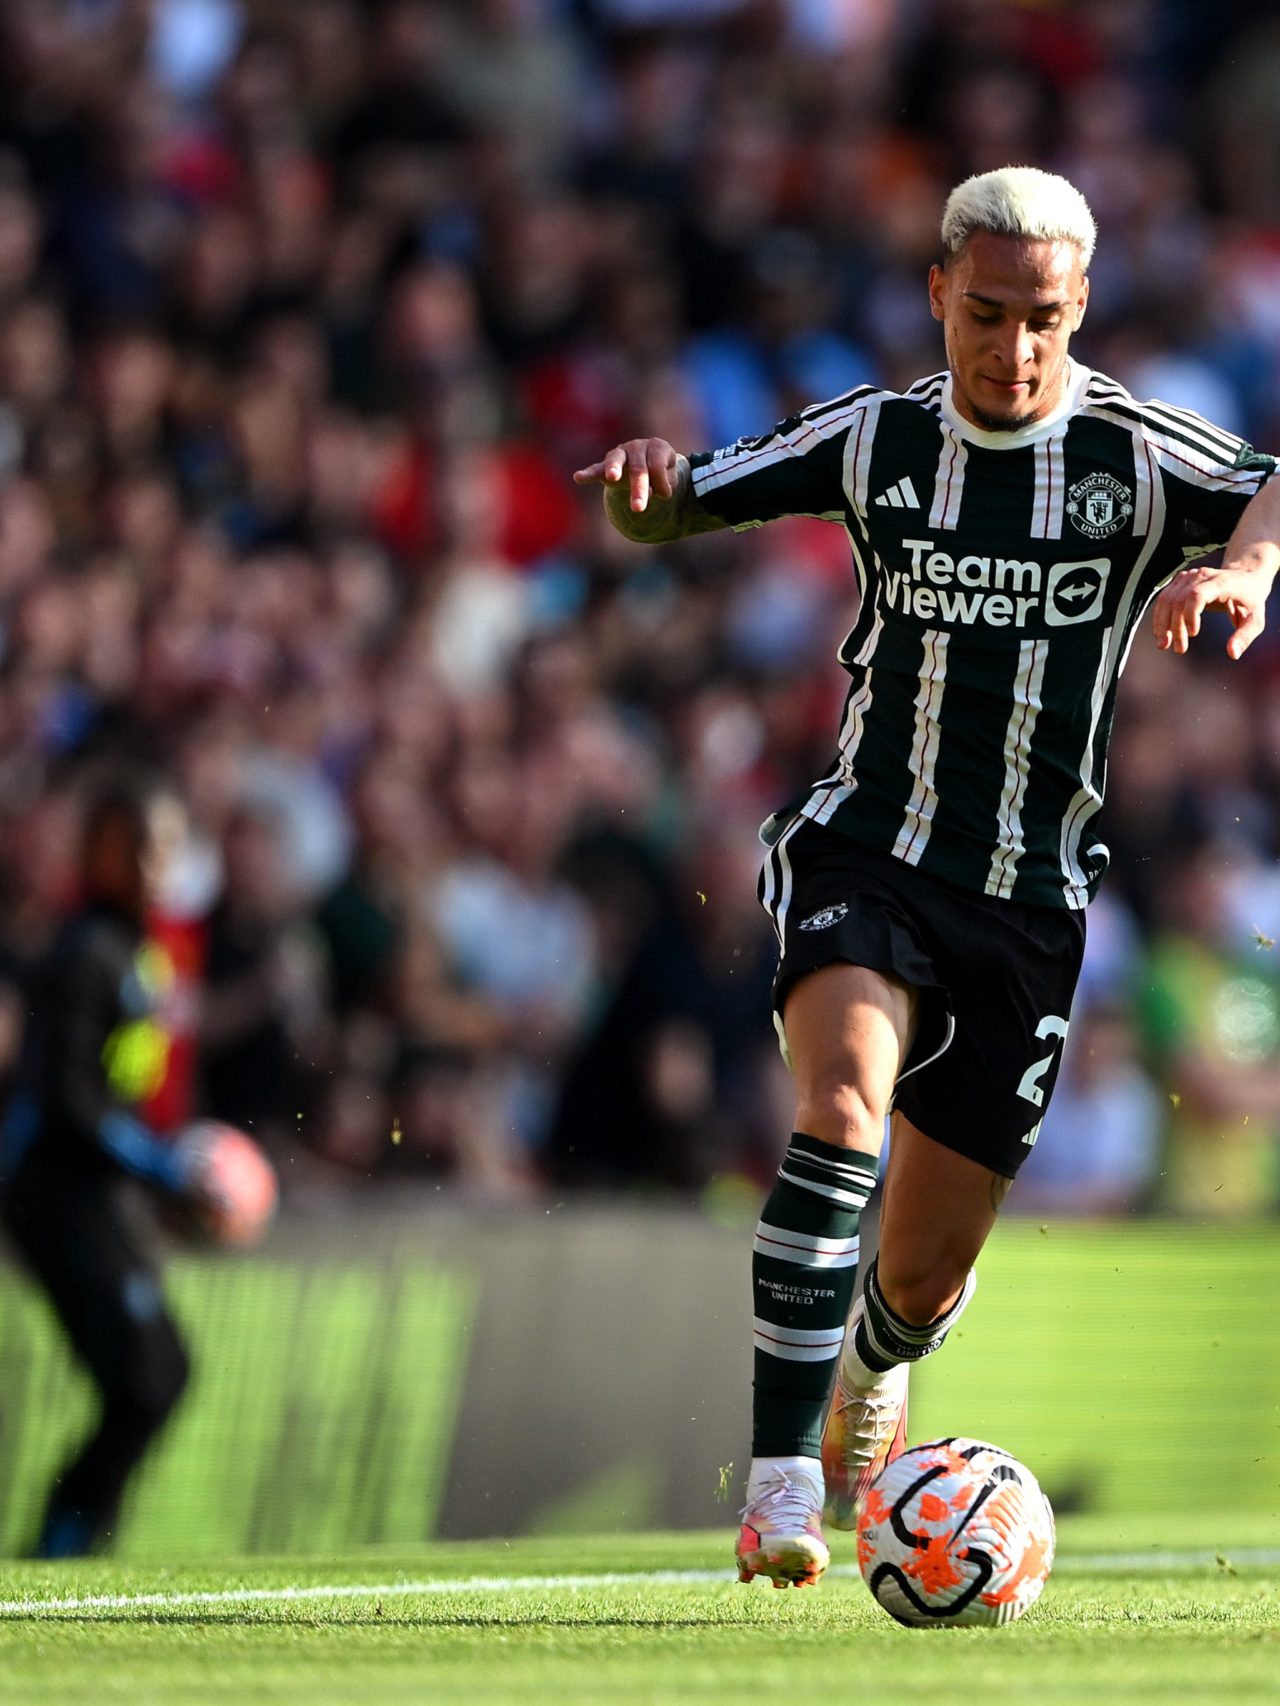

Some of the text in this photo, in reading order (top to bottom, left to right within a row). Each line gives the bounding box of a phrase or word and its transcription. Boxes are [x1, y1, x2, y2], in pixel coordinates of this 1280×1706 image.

[1073, 477, 1127, 500] MANCHESTER
[1080, 523, 1118, 535] UNITED
[902, 538, 1042, 592] Team
[884, 570, 1039, 628] Viewer
[1016, 1014, 1069, 1108] 2
[758, 1277, 836, 1298] MANCHESTER
[771, 1290, 814, 1305] UNITED
